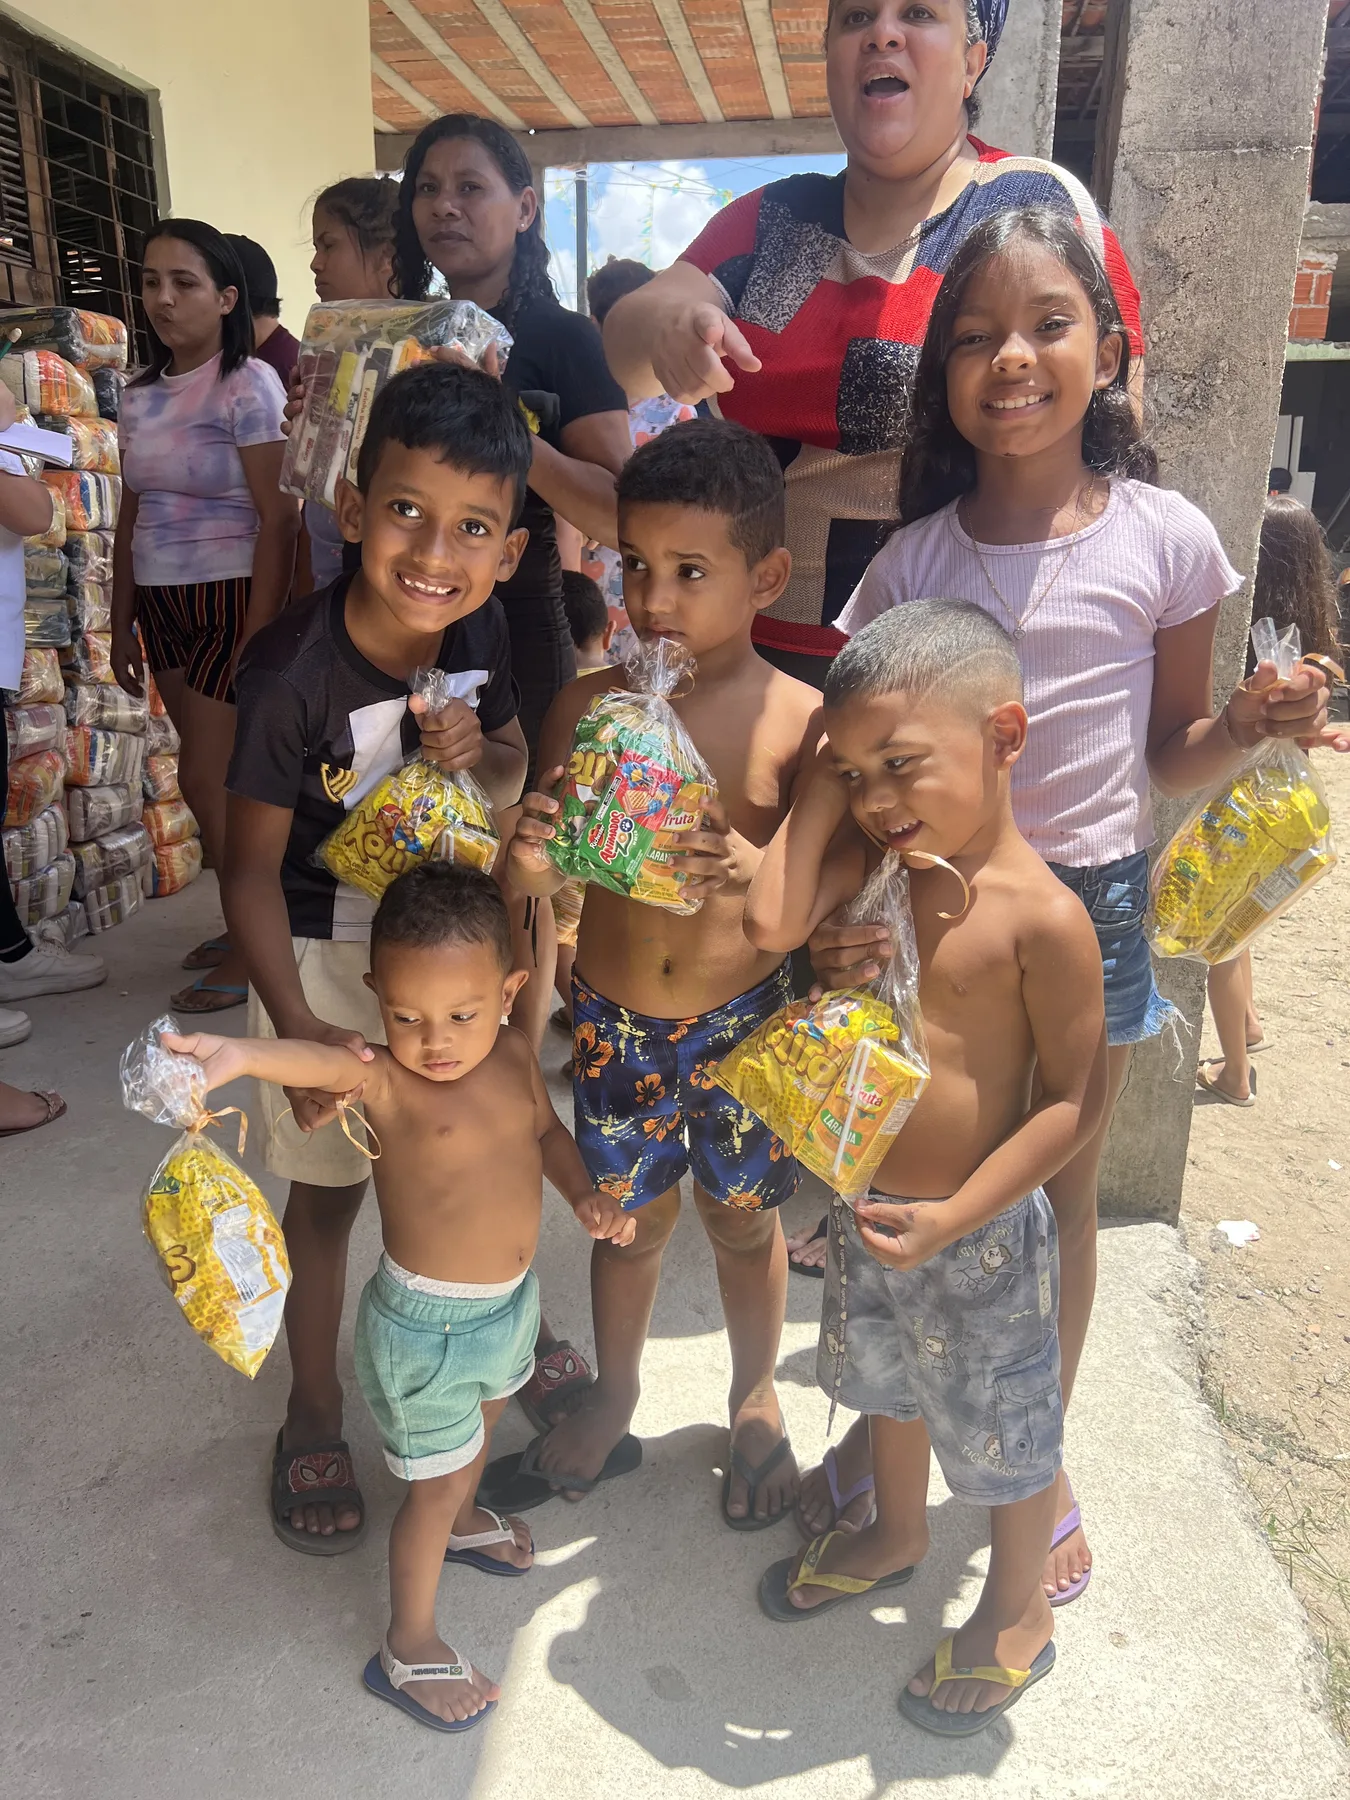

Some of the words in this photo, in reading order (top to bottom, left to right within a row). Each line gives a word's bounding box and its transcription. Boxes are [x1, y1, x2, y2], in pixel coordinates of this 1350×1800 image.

[664, 812, 695, 827] fruta
[589, 824, 605, 849] Richester
[823, 1113, 857, 1145] LARAJA
[960, 1444, 989, 1467] TIGOR
[990, 1460, 1020, 1477] BABY
